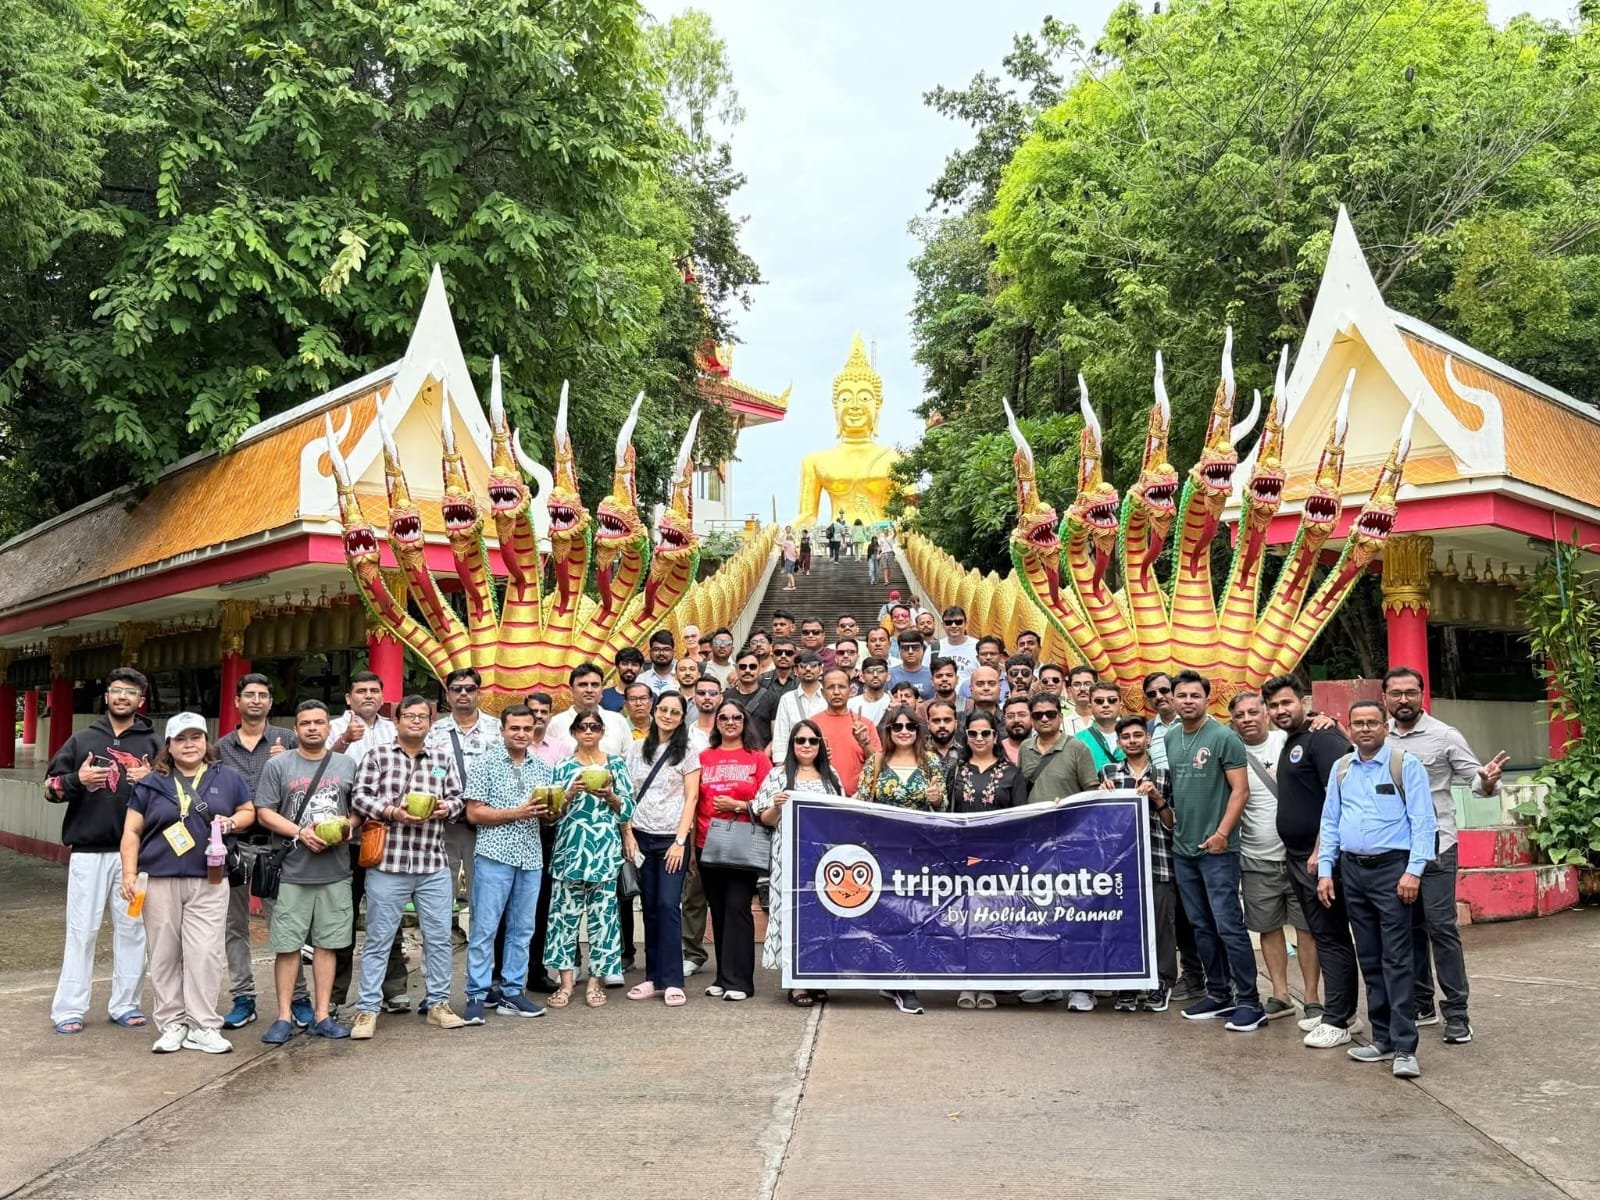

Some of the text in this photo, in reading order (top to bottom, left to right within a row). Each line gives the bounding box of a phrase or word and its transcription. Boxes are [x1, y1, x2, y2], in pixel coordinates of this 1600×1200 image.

[892, 866, 1113, 906] tripnavigate
[947, 906, 1123, 926] by Holiday Planner
